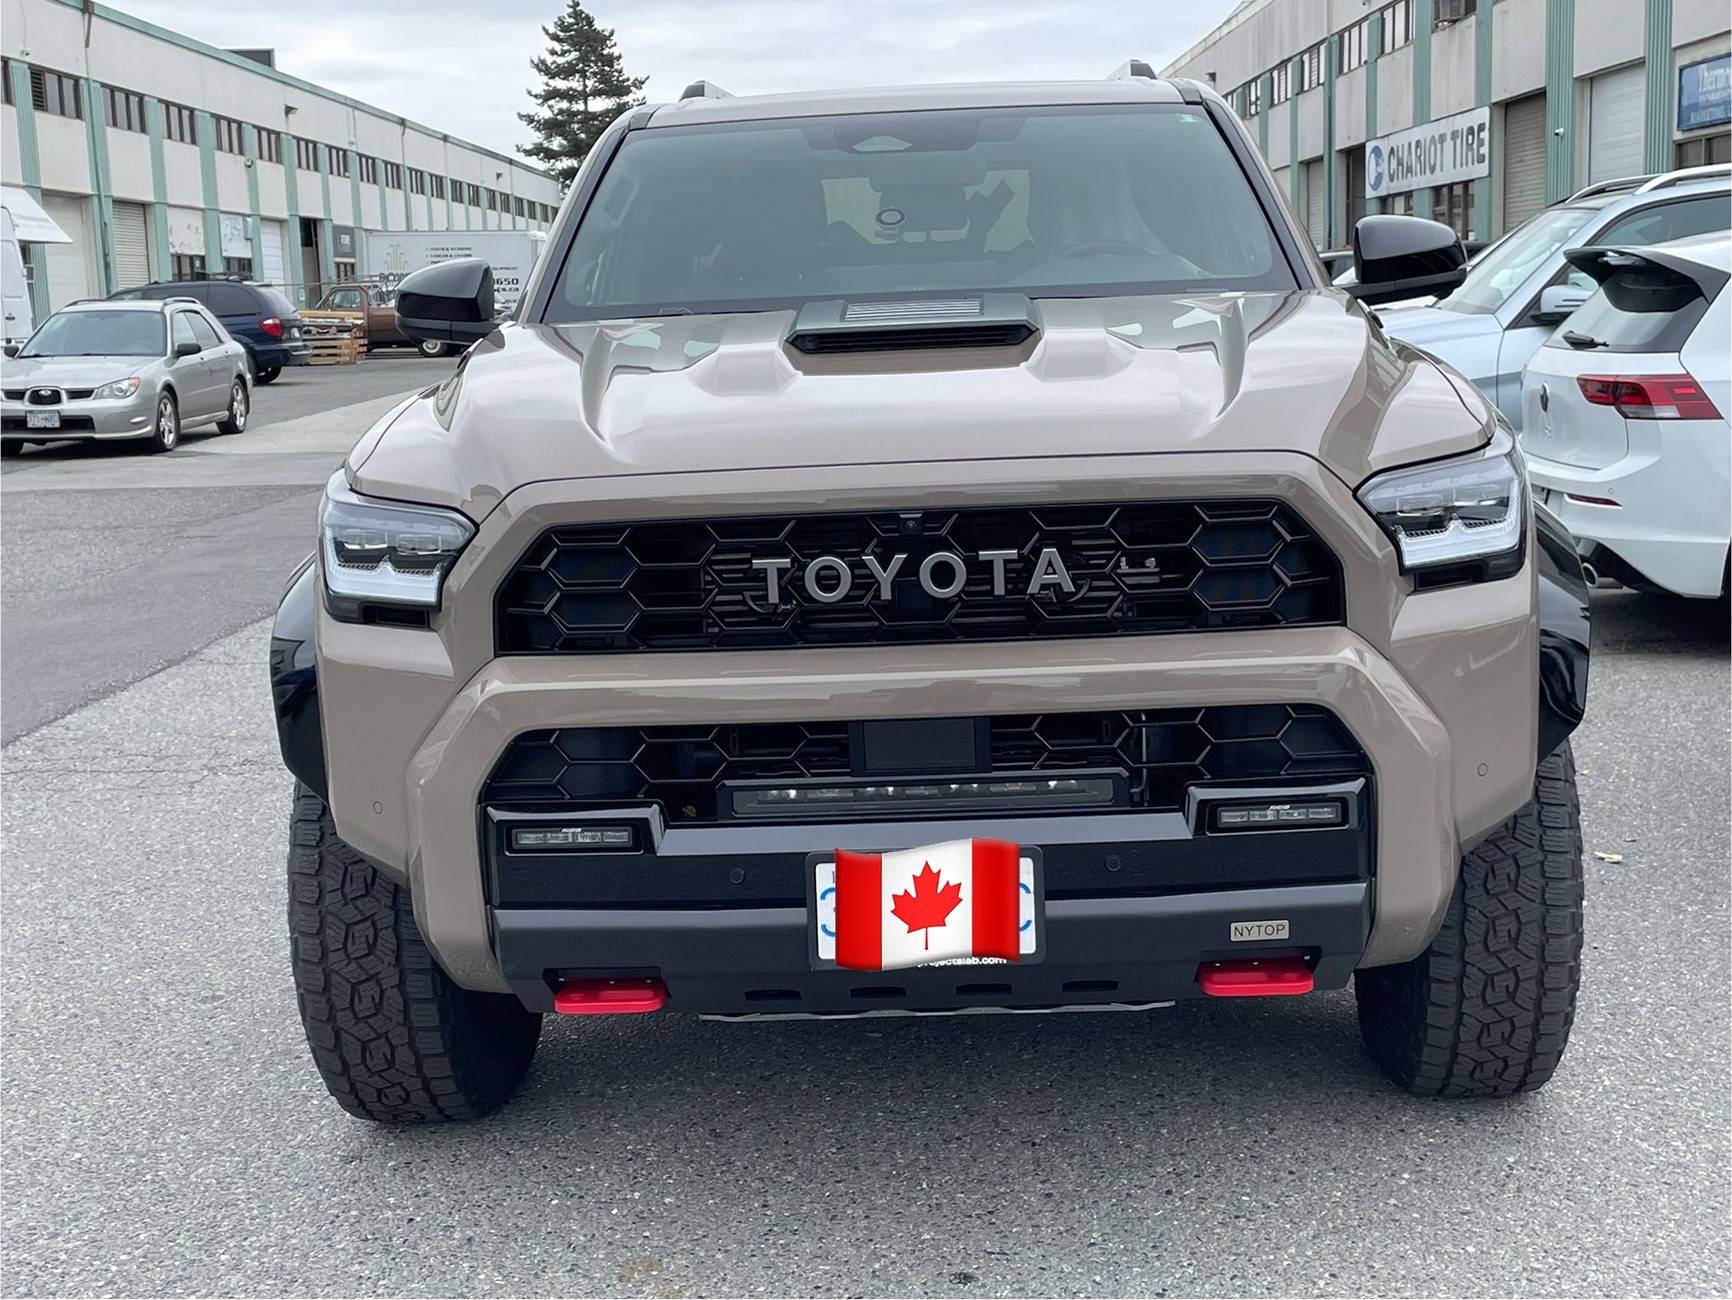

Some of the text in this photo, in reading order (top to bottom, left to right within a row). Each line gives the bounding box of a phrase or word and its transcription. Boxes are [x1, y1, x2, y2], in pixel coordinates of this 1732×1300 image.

[1387, 122, 1487, 183] CHARIOT TIRE
[493, 277, 519, 286] 650
[751, 547, 1076, 605] TOYOTA
[1234, 924, 1286, 937] NYTOP
[917, 956, 1007, 968] ojectslab.com
